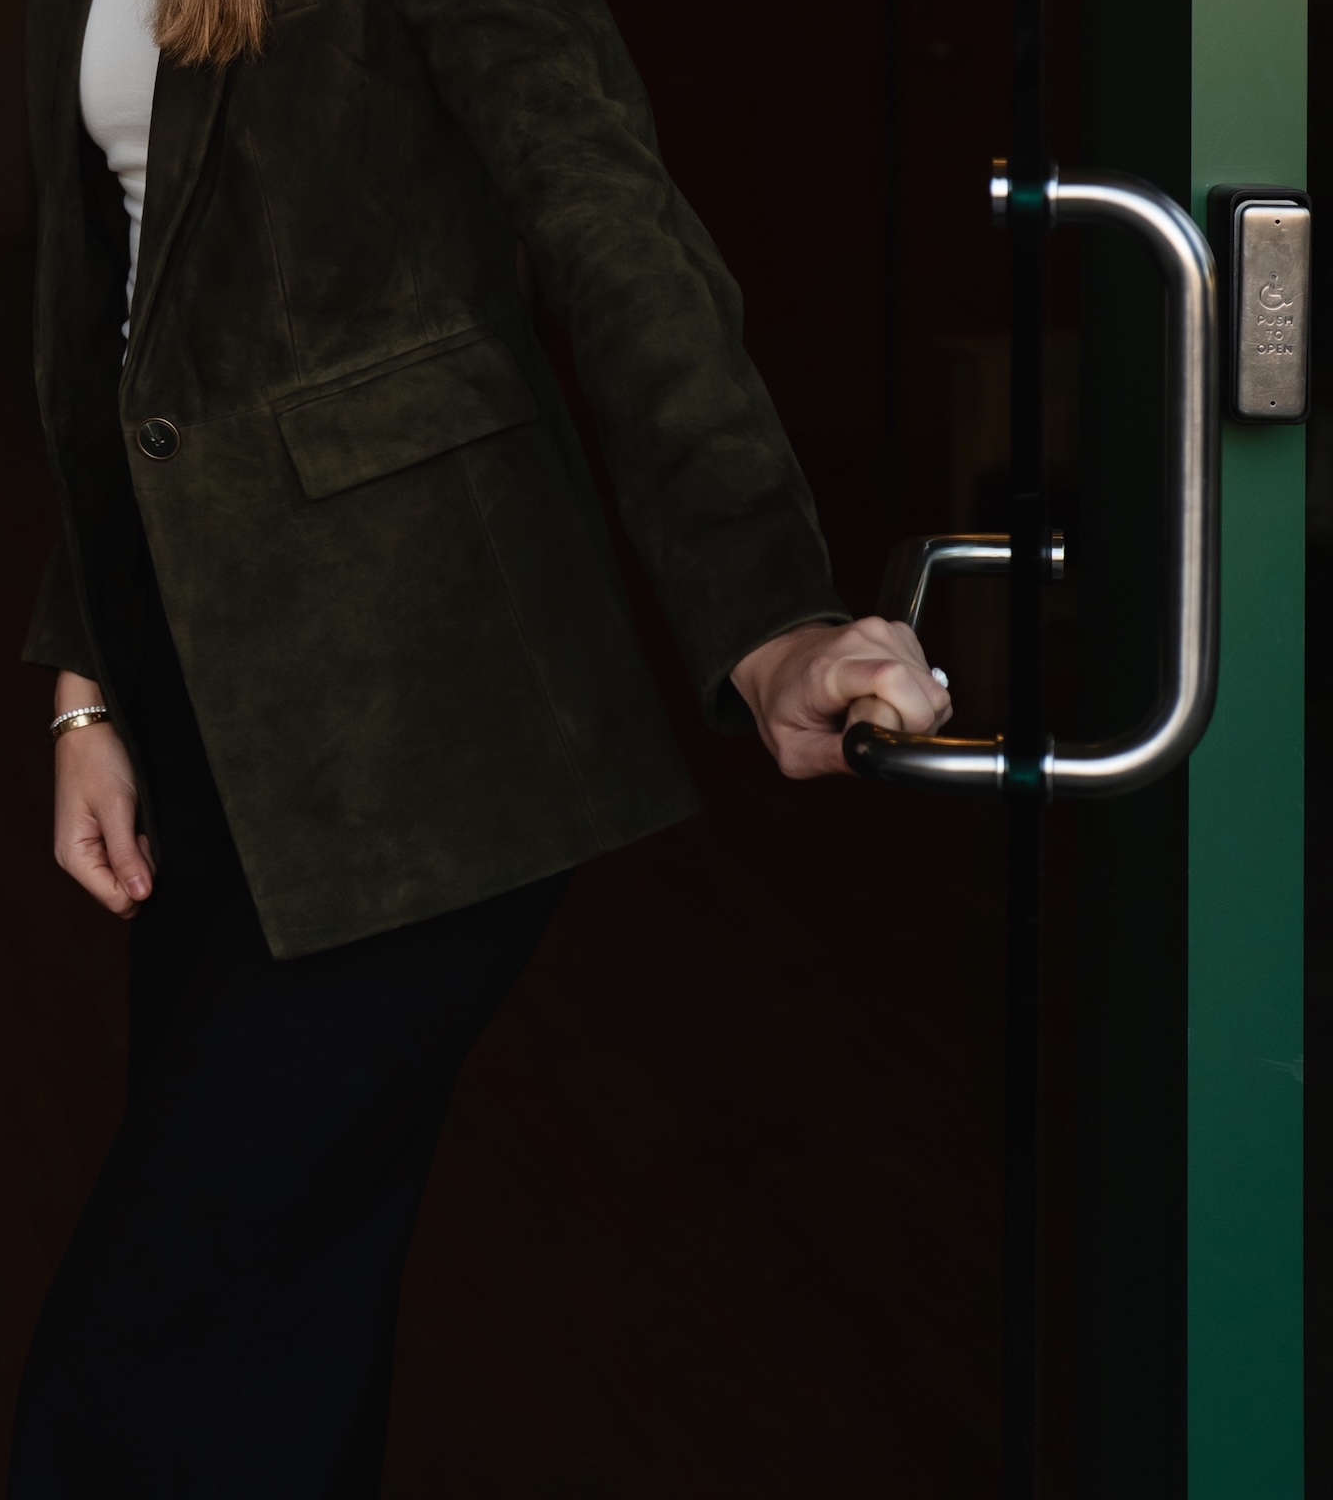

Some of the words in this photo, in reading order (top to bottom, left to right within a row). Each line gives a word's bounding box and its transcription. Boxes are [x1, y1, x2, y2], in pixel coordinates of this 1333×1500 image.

[1257, 315, 1294, 327] PUSH
[1266, 330, 1284, 341] TO
[1256, 344, 1293, 356] OPEN
